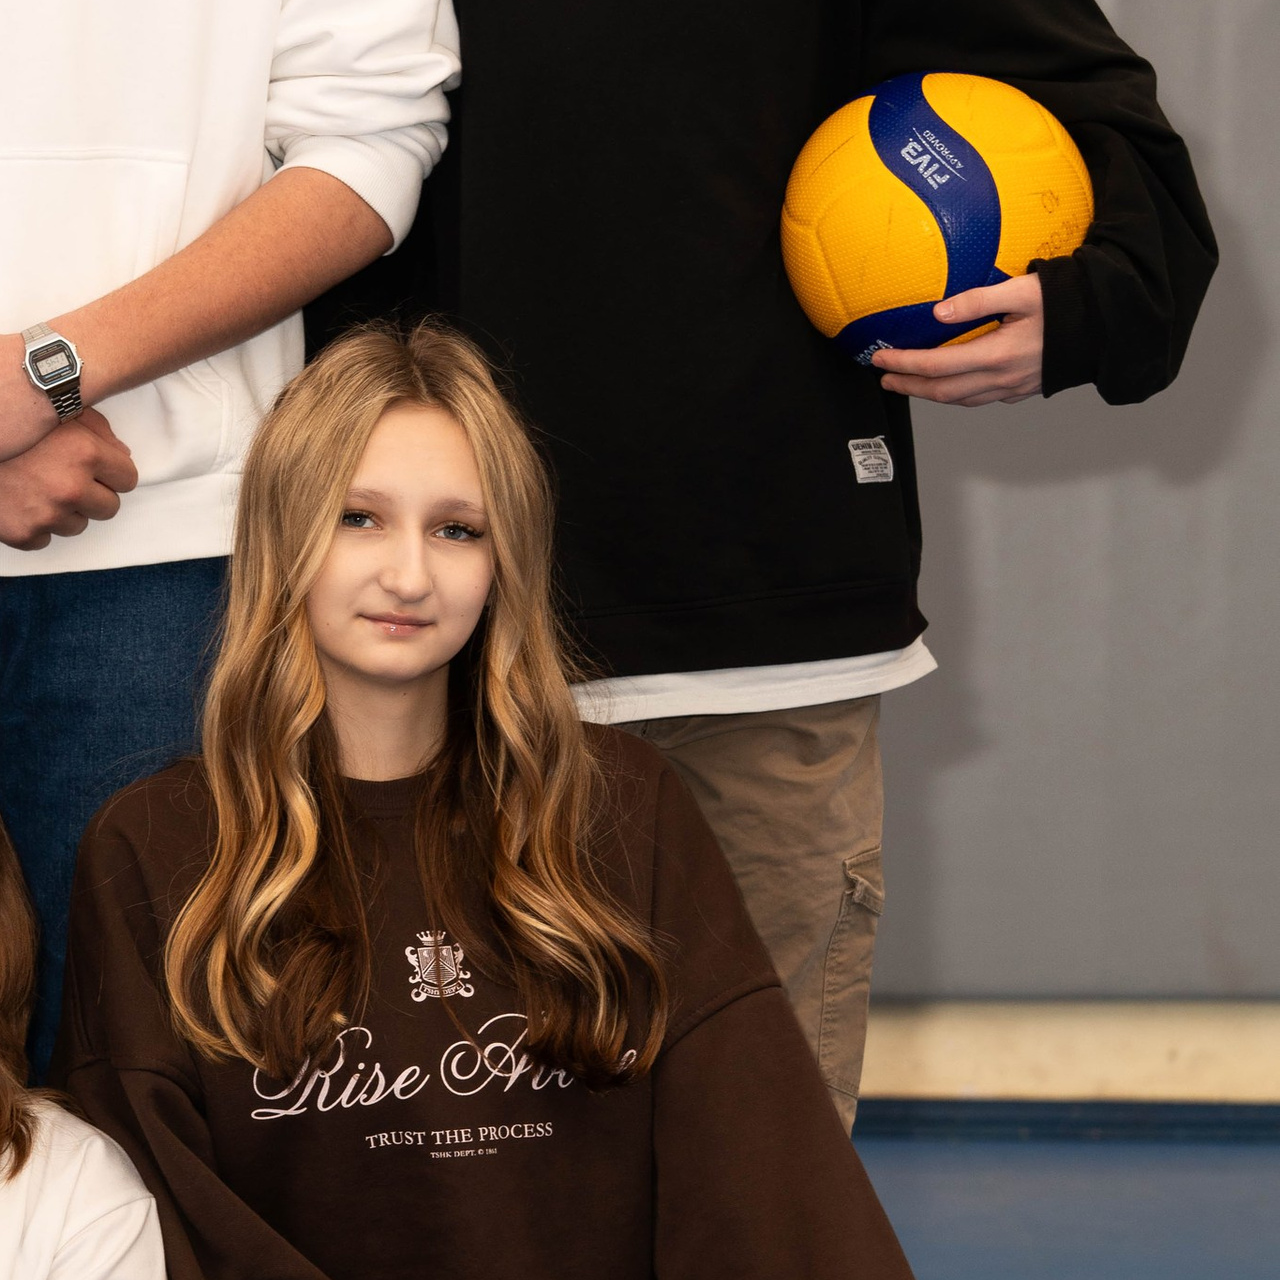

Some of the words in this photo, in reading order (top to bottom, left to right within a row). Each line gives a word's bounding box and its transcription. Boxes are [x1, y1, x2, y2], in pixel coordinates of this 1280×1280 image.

[923, 129, 964, 169] APPROVED
[251, 1025, 431, 1120] Rise
[365, 1131, 426, 1149] TRUST
[431, 1128, 473, 1145] THE
[478, 1122, 553, 1141] PROCESS
